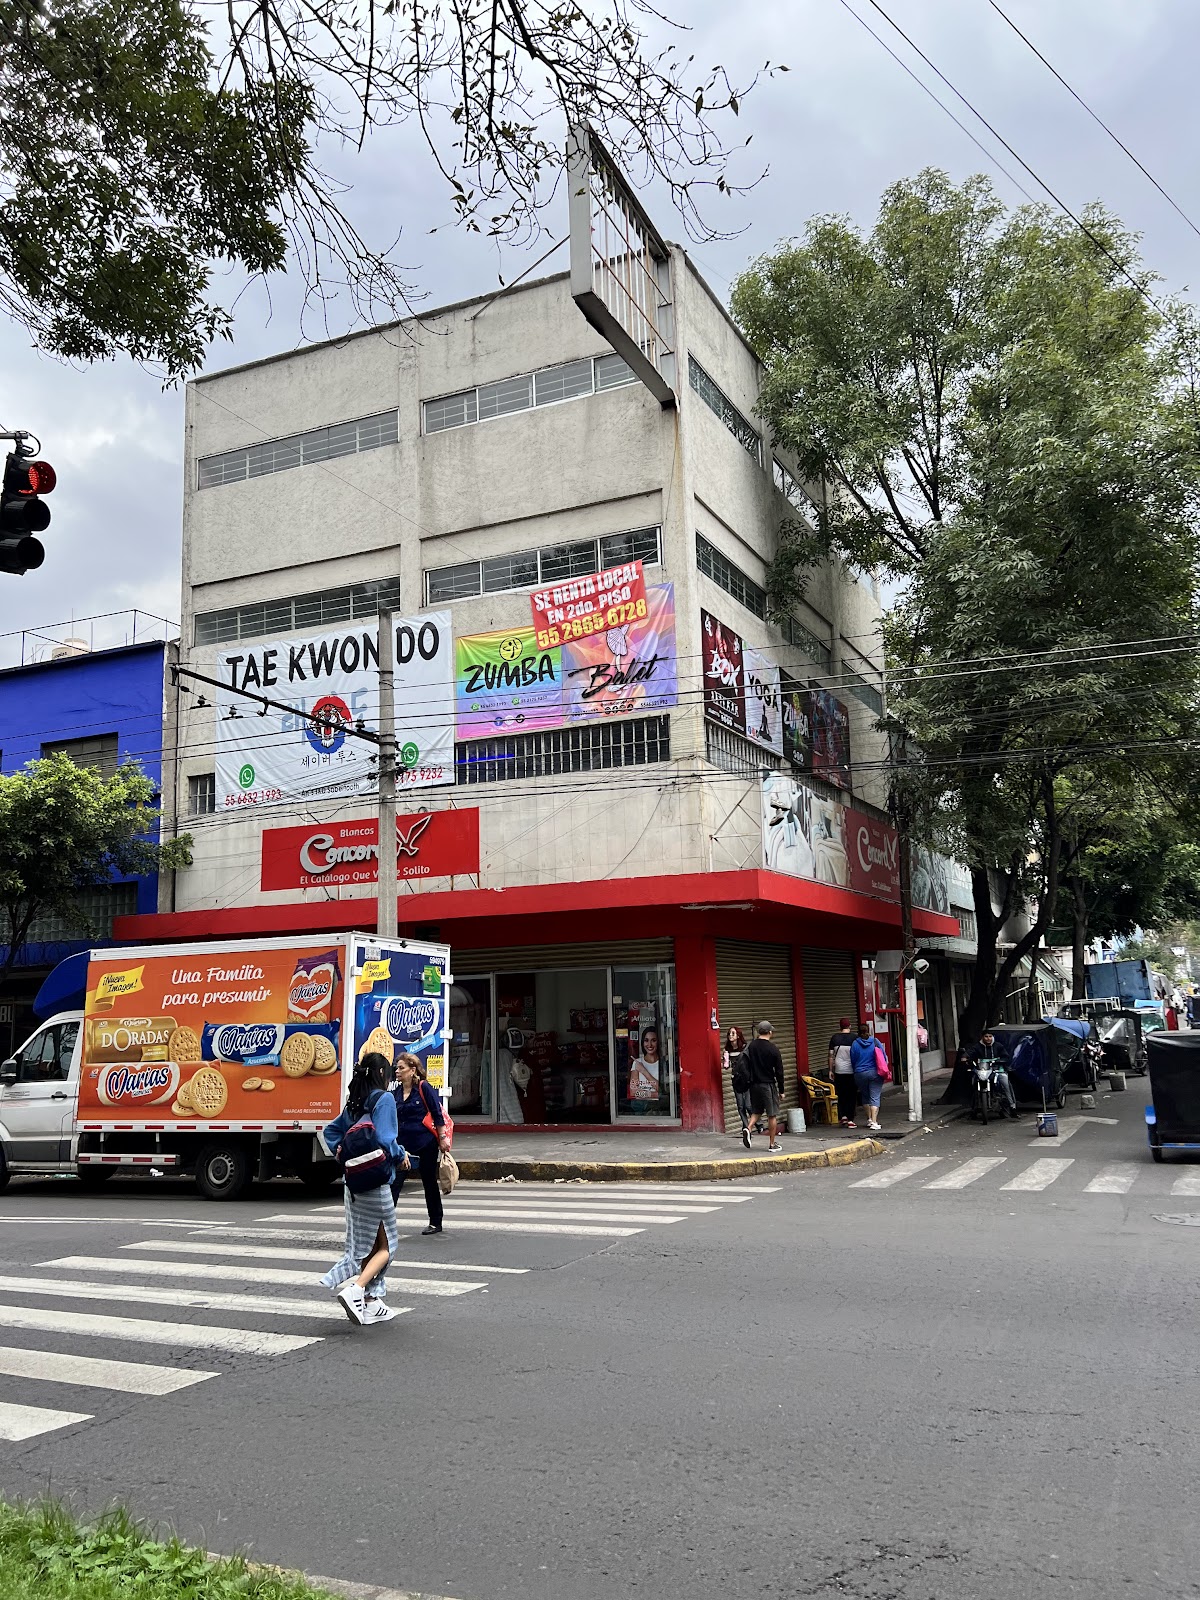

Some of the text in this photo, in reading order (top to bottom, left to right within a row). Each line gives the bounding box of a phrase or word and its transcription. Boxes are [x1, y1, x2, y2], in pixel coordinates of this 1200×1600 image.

[533, 564, 640, 611] SE RENTA LOCAL
[547, 586, 631, 625] EN 2do. PISO
[538, 627, 560, 647] 55
[607, 598, 647, 626] 6728
[226, 622, 439, 691] TAE KWON DO
[463, 654, 556, 693] ZUMBA
[748, 672, 779, 712] YOGA
[420, 766, 443, 780] 9232
[225, 788, 282, 806] 55 6632 1993
[340, 827, 374, 838] Blancos
[300, 833, 379, 874] Concor
[300, 875, 308, 885] El
[311, 873, 350, 885] Catálogo
[352, 871, 371, 881] Que
[403, 865, 430, 876] Solito
[102, 974, 126, 987] ¡Nueva
[107, 978, 138, 993] Imagen!
[171, 964, 265, 985] Una Familia
[161, 986, 273, 1009] para presumir
[101, 1027, 169, 1051] DORADAS
